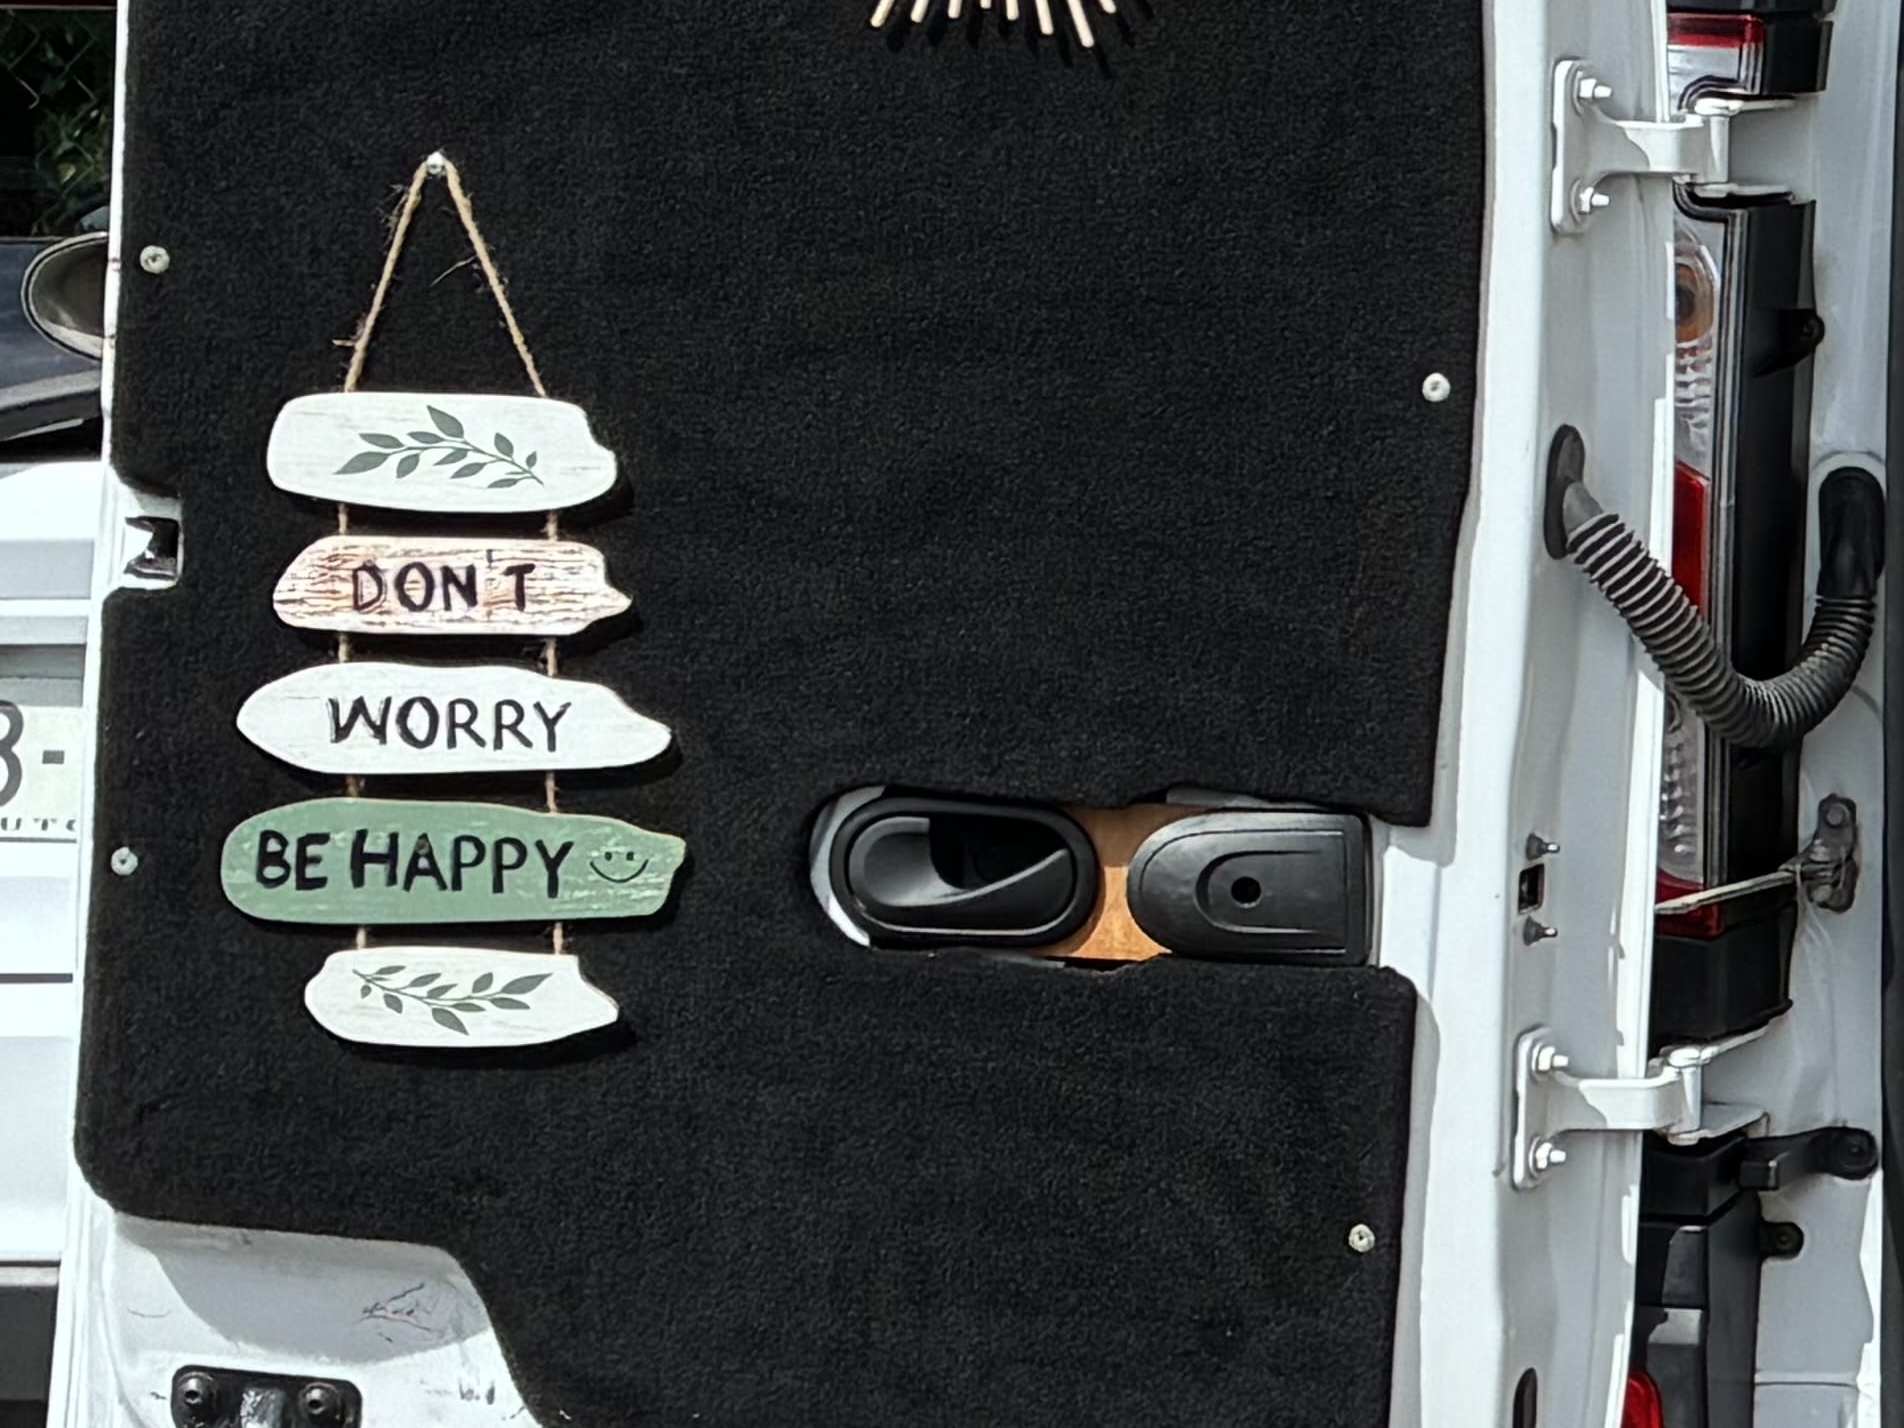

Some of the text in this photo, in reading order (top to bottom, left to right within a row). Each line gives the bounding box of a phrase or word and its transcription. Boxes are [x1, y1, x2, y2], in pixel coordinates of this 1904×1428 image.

[351, 548, 536, 612] DON'T
[325, 695, 572, 752] WORRY
[255, 828, 575, 899] BE HAPPY
